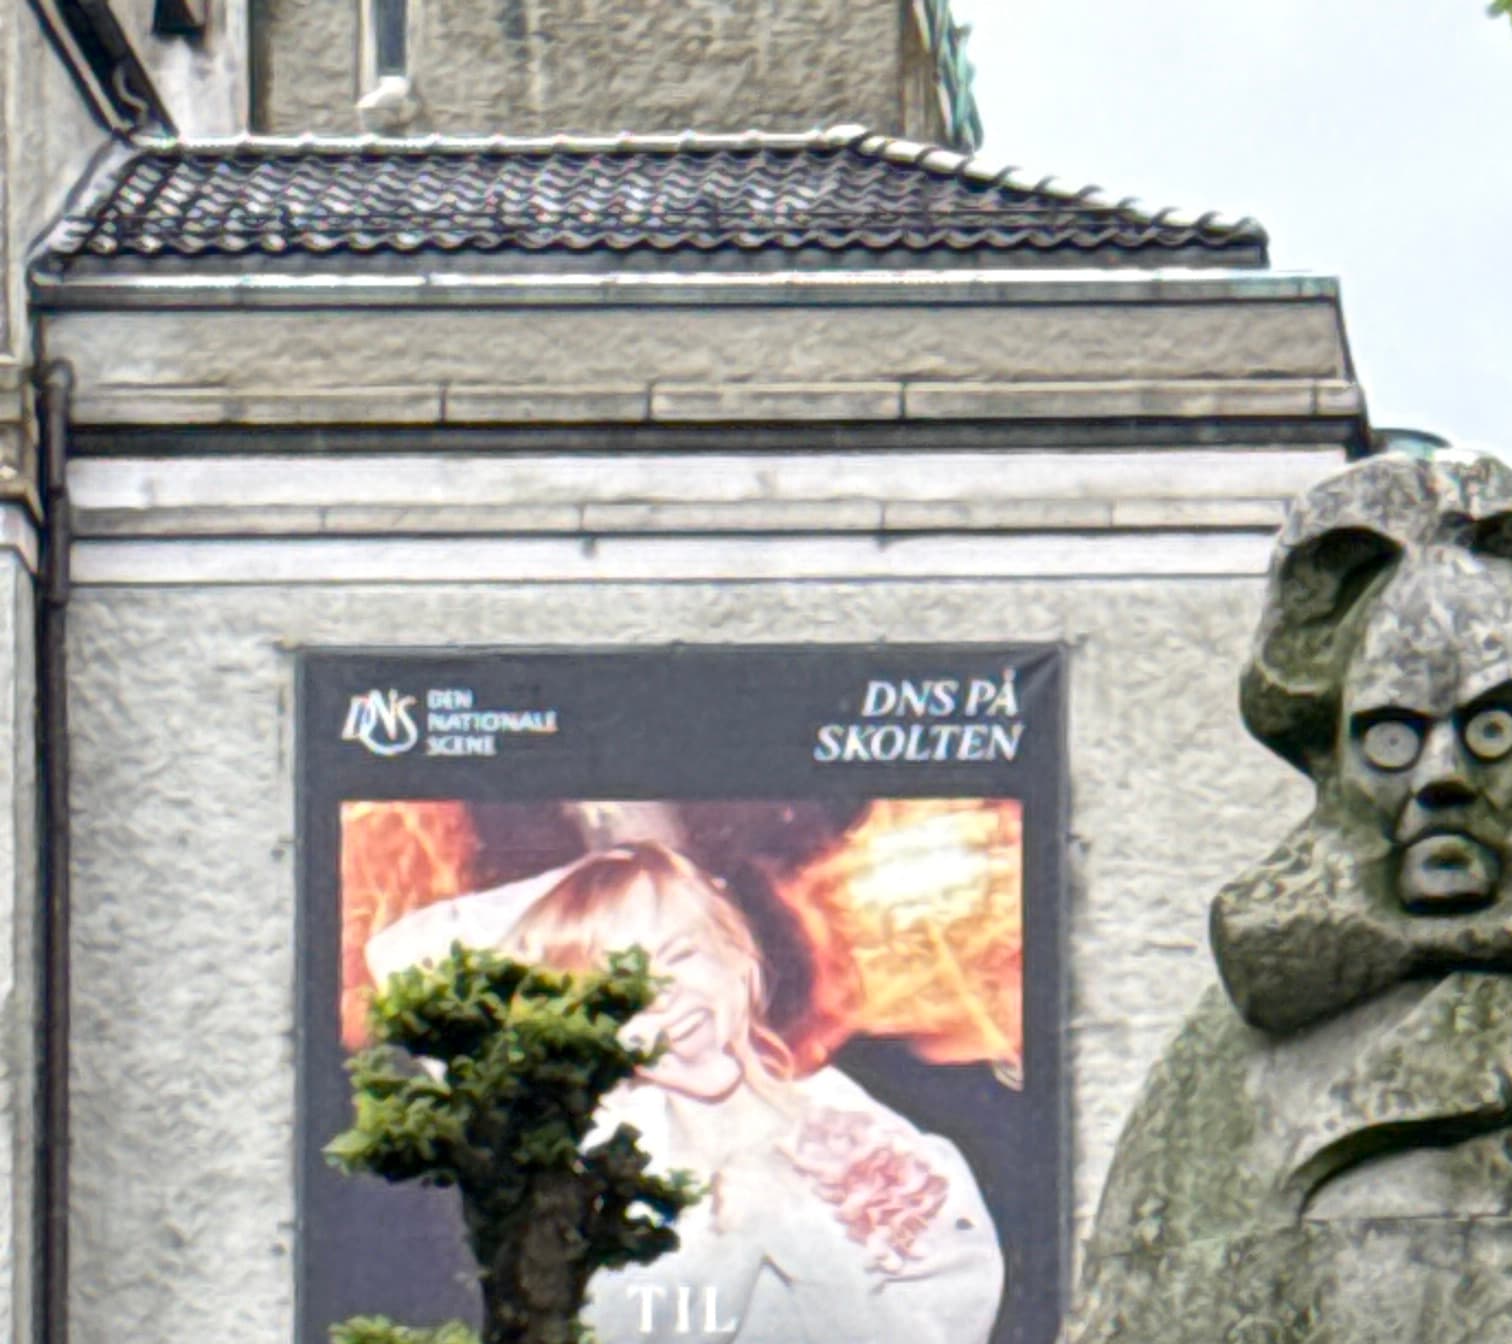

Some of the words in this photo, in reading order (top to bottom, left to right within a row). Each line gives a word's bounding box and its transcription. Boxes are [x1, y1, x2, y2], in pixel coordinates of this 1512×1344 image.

[427, 689, 473, 709] DEN
[861, 679, 960, 717] DNS
[965, 667, 1018, 717] PÅ
[427, 711, 558, 733] NATIONALE
[427, 735, 497, 756] SCENE
[813, 723, 1025, 762] SKOLTEN
[626, 1284, 738, 1334] TIL
